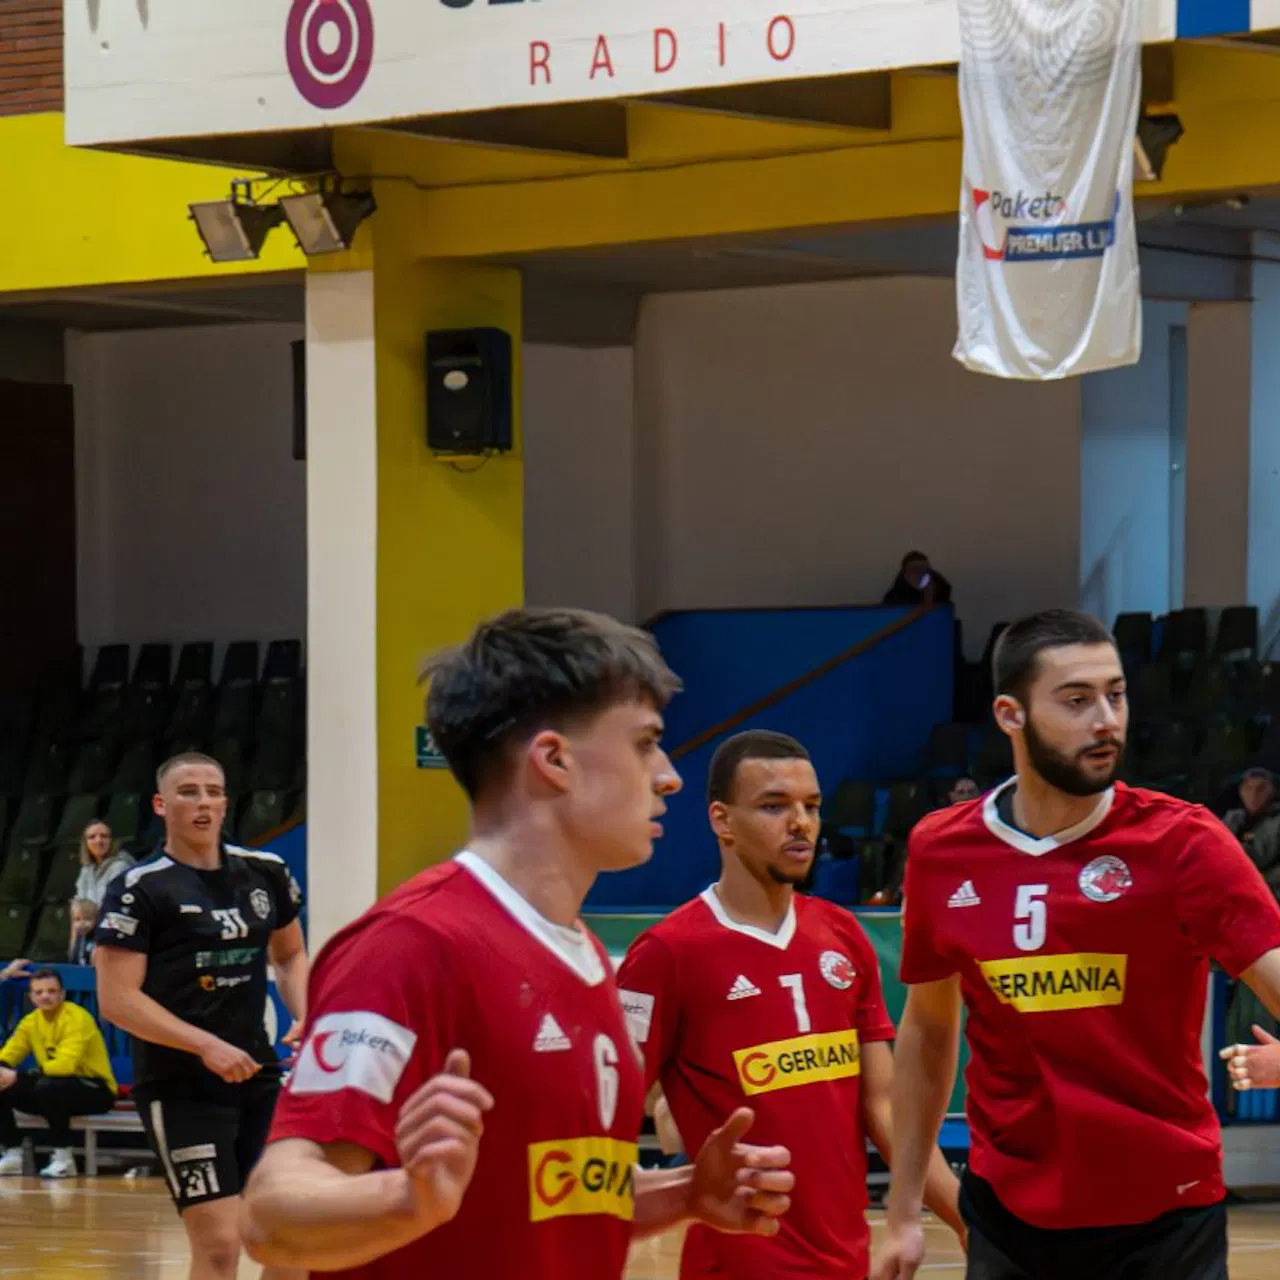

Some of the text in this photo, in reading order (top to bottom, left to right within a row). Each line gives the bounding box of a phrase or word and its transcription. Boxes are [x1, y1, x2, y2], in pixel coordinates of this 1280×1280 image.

[529, 15, 796, 86] RADIO
[211, 907, 249, 940] 31
[1013, 884, 1049, 951] 5
[593, 1033, 619, 1130] 6
